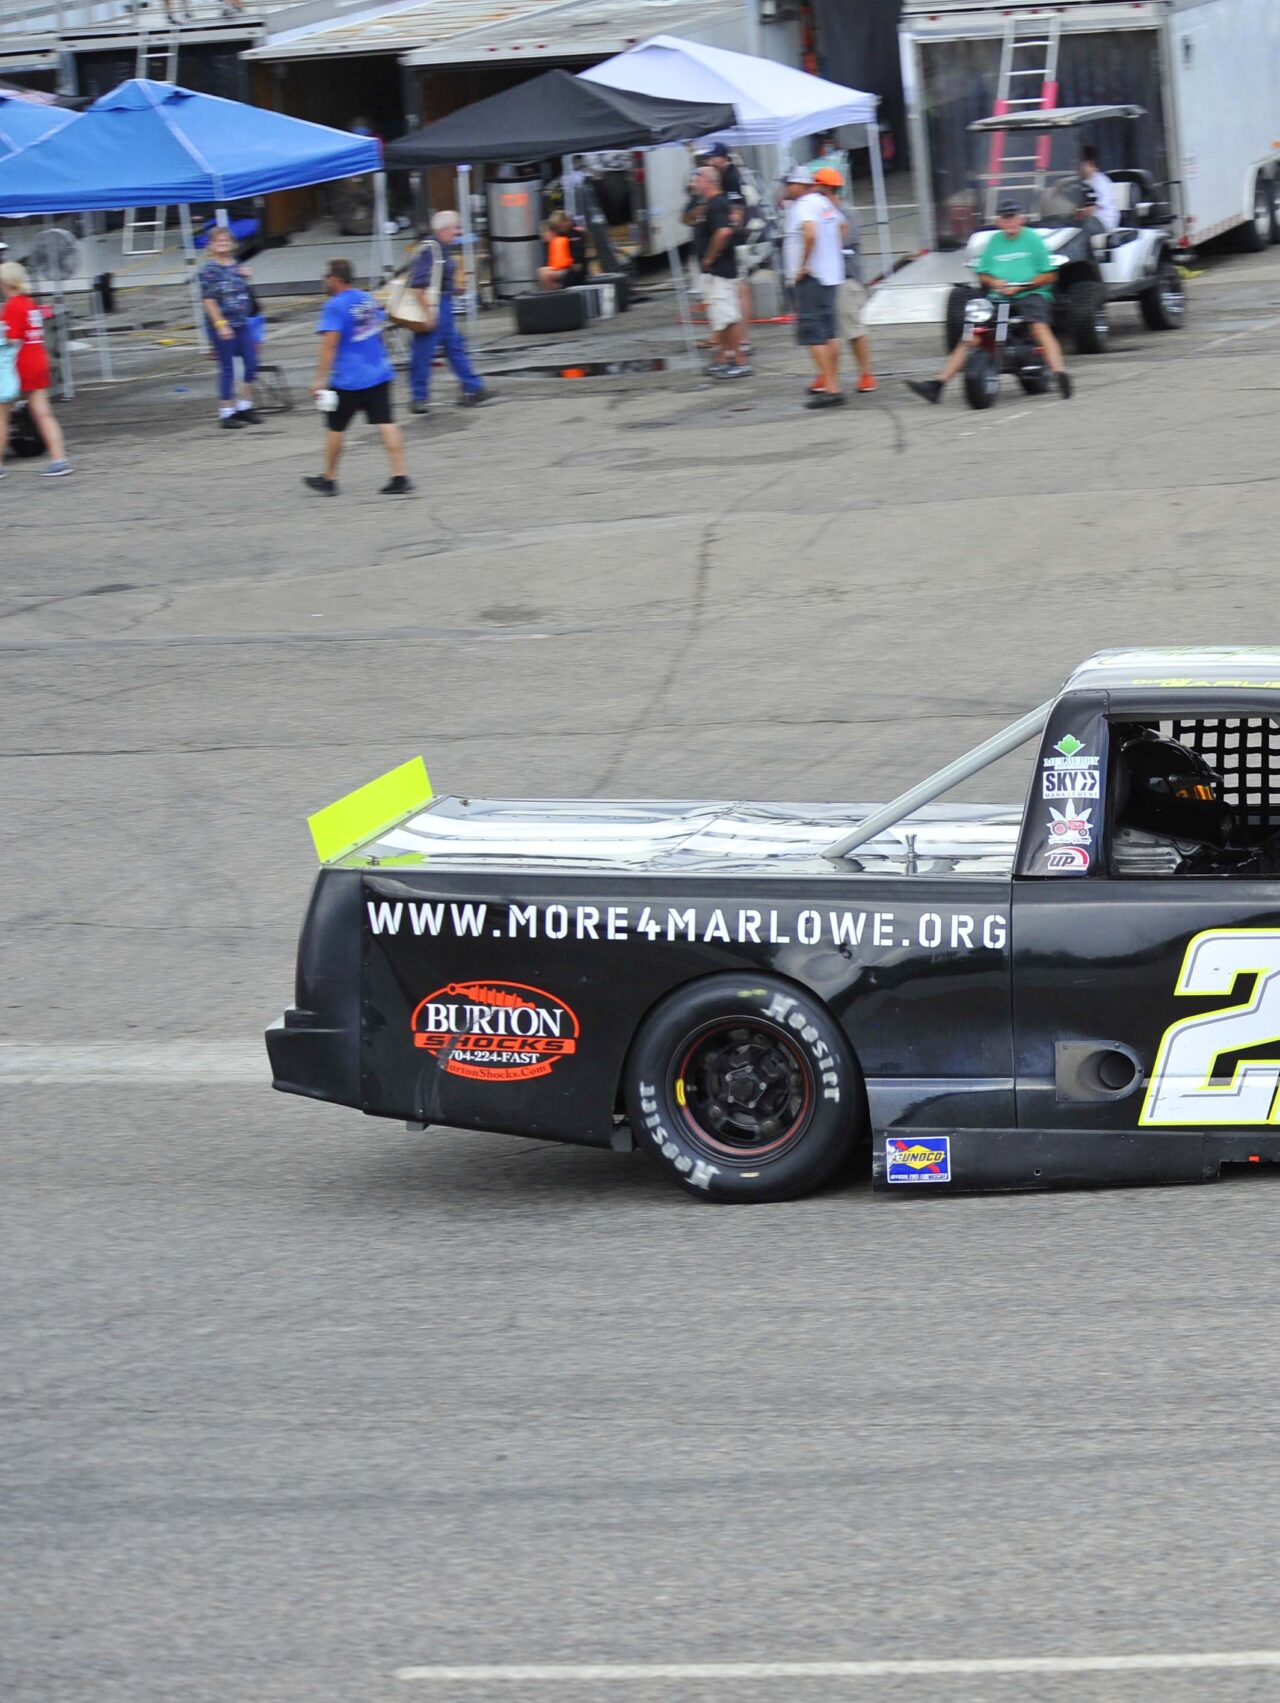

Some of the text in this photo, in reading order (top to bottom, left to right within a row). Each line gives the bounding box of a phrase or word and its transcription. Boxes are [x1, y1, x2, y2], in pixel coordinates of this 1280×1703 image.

[1045, 772, 1079, 792] SKY
[366, 901, 1007, 949] WWW.MORE4MARLOWE.ORG
[425, 1003, 564, 1037] BURTON
[423, 1035, 565, 1051] SHOCKS
[448, 1050, 540, 1064] 704-224-FAST
[447, 1064, 547, 1080] urtonShocks.Com
